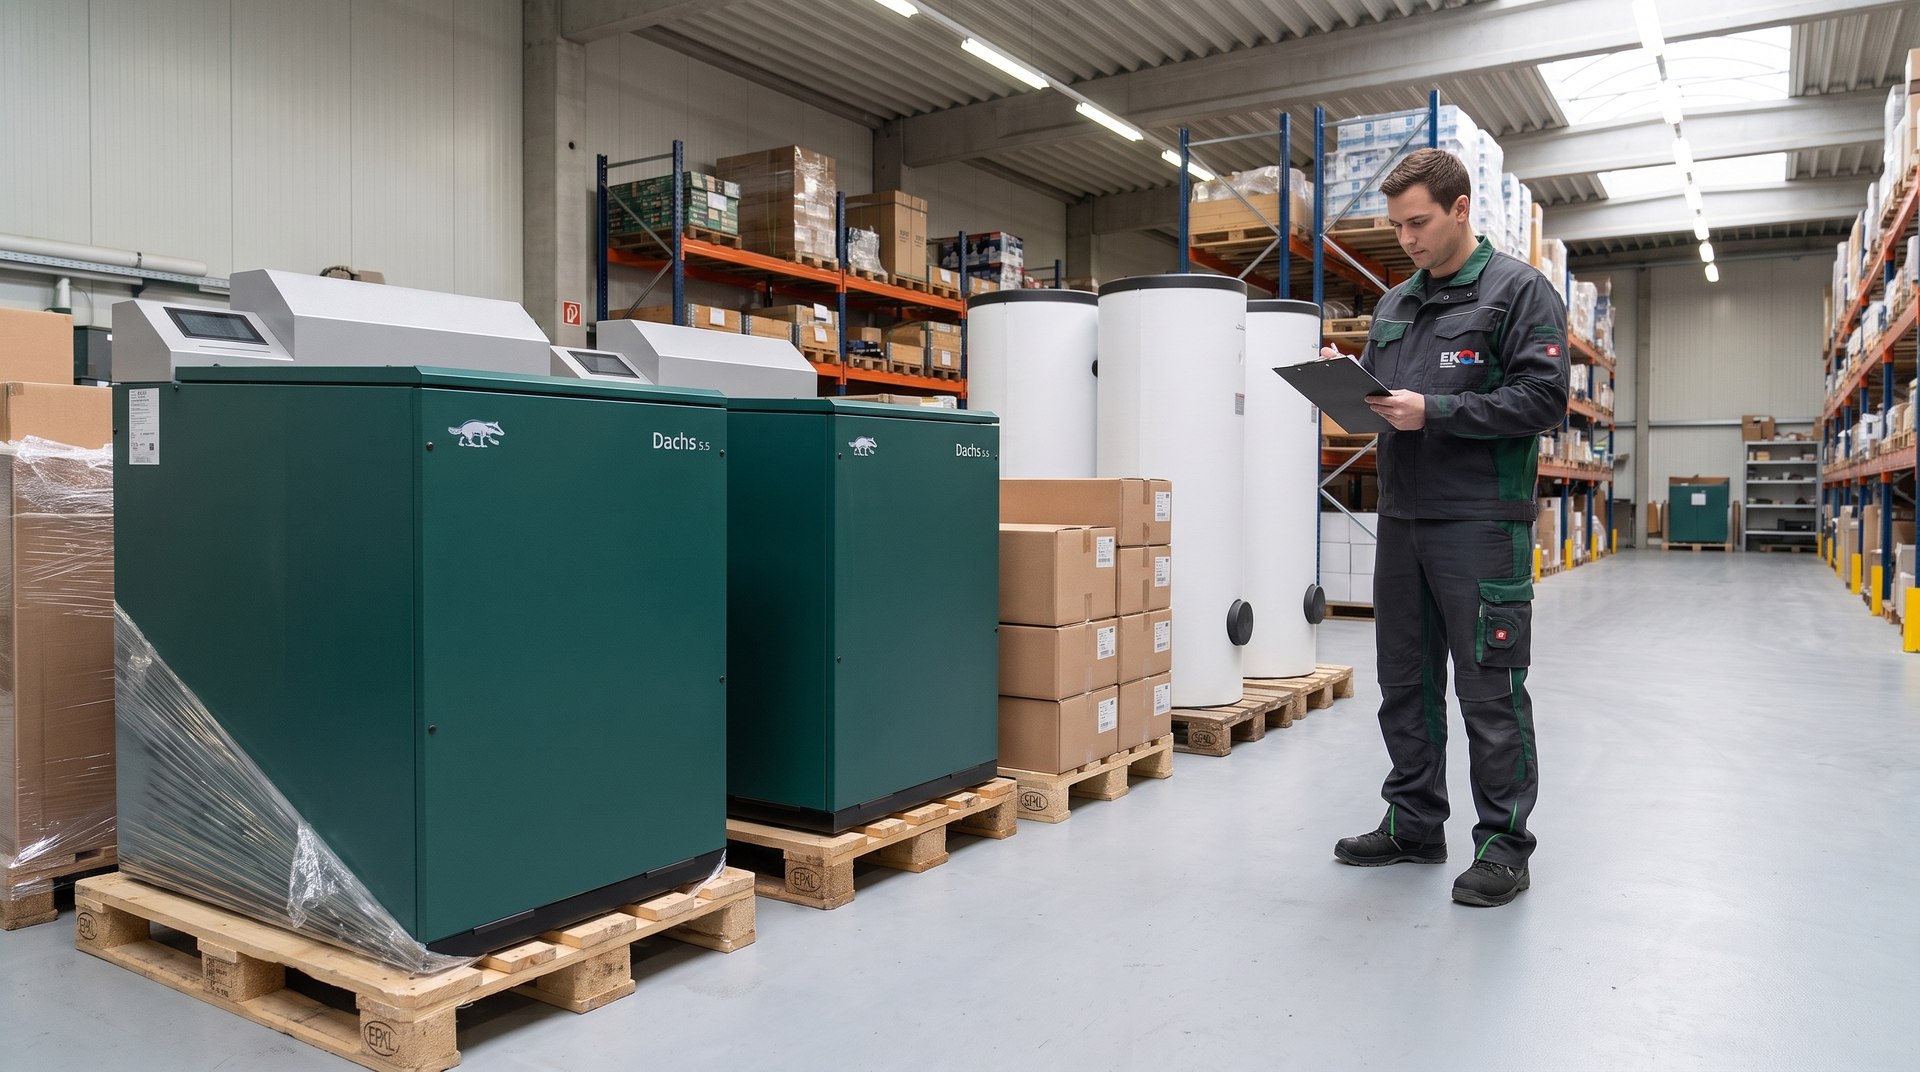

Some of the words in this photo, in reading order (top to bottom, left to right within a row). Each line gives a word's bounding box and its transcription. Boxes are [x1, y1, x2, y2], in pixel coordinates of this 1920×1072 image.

[1440, 349, 1484, 365] EKOL
[653, 431, 697, 450] Dachs
[956, 443, 981, 457] Dachs
